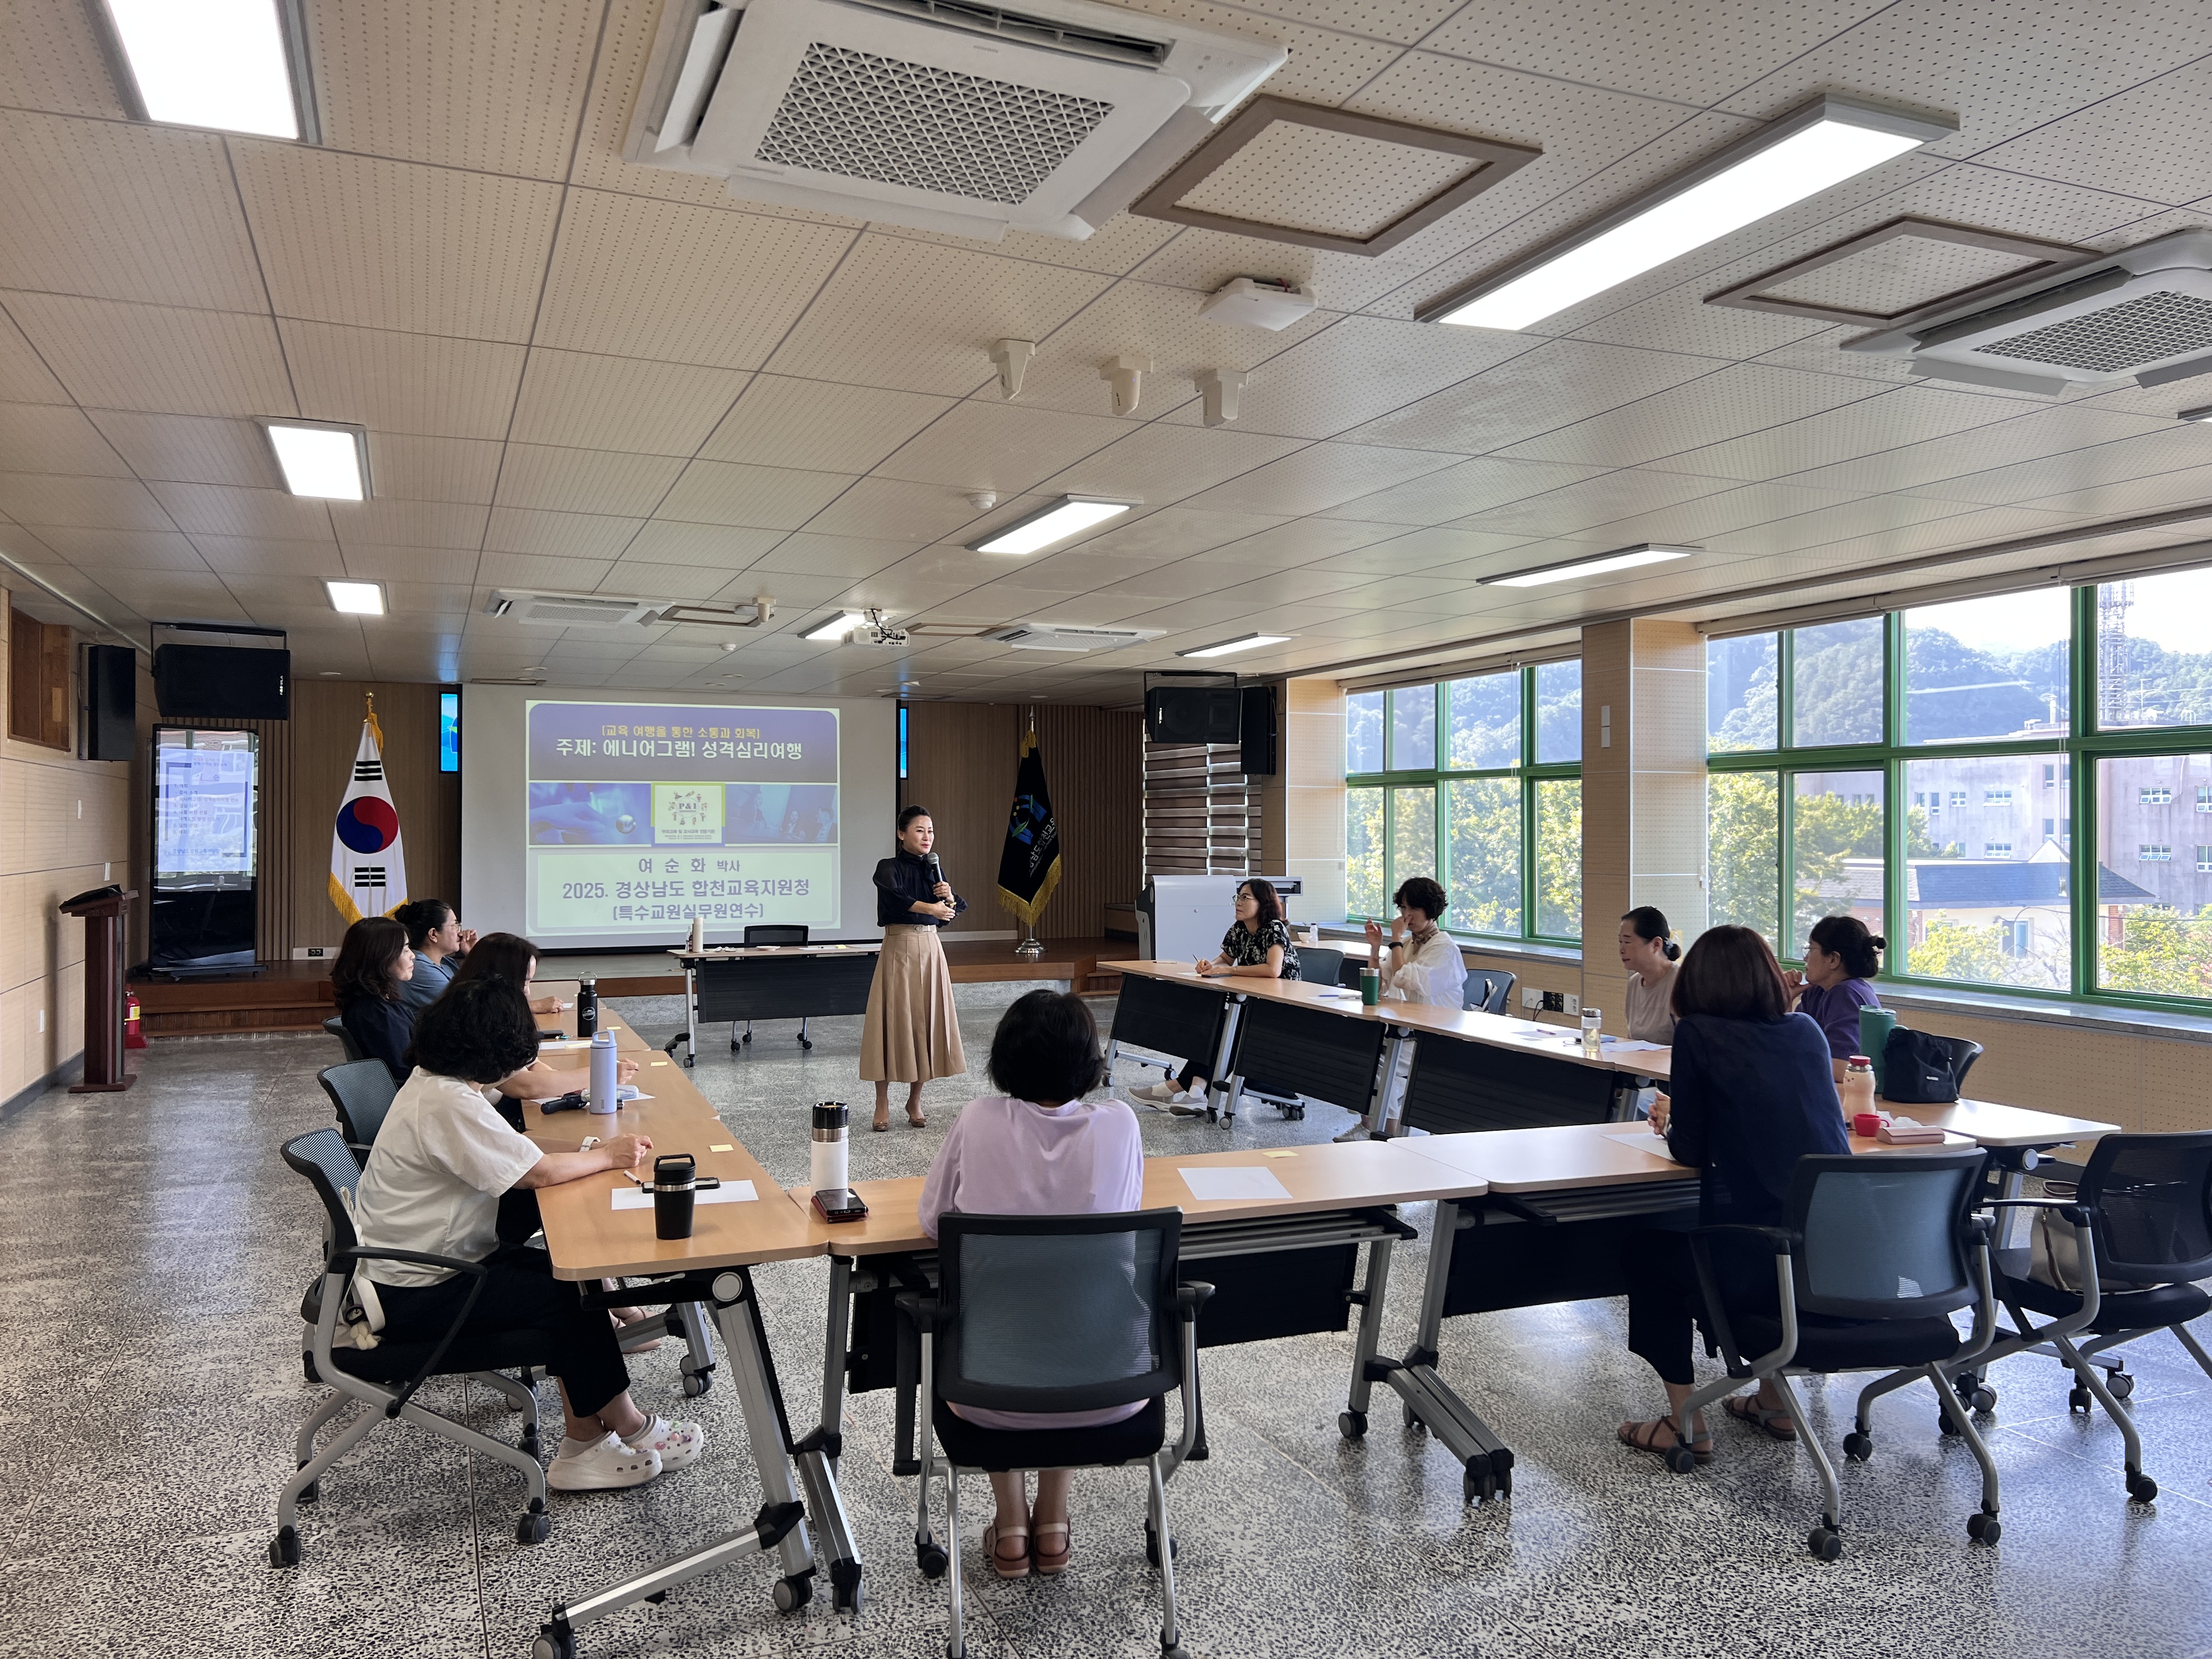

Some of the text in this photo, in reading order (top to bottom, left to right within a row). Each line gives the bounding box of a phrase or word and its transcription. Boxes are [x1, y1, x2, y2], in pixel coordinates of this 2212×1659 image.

[633, 725, 667, 738] 여행을
[672, 726, 693, 738] 통한
[697, 727, 731, 739] 소통과
[556, 738, 803, 760] 주제: 에니어그램! 성격심리여행
[716, 860, 741, 872] 박사
[562, 878, 810, 899] 2025. 경상남도 합천교육지원청
